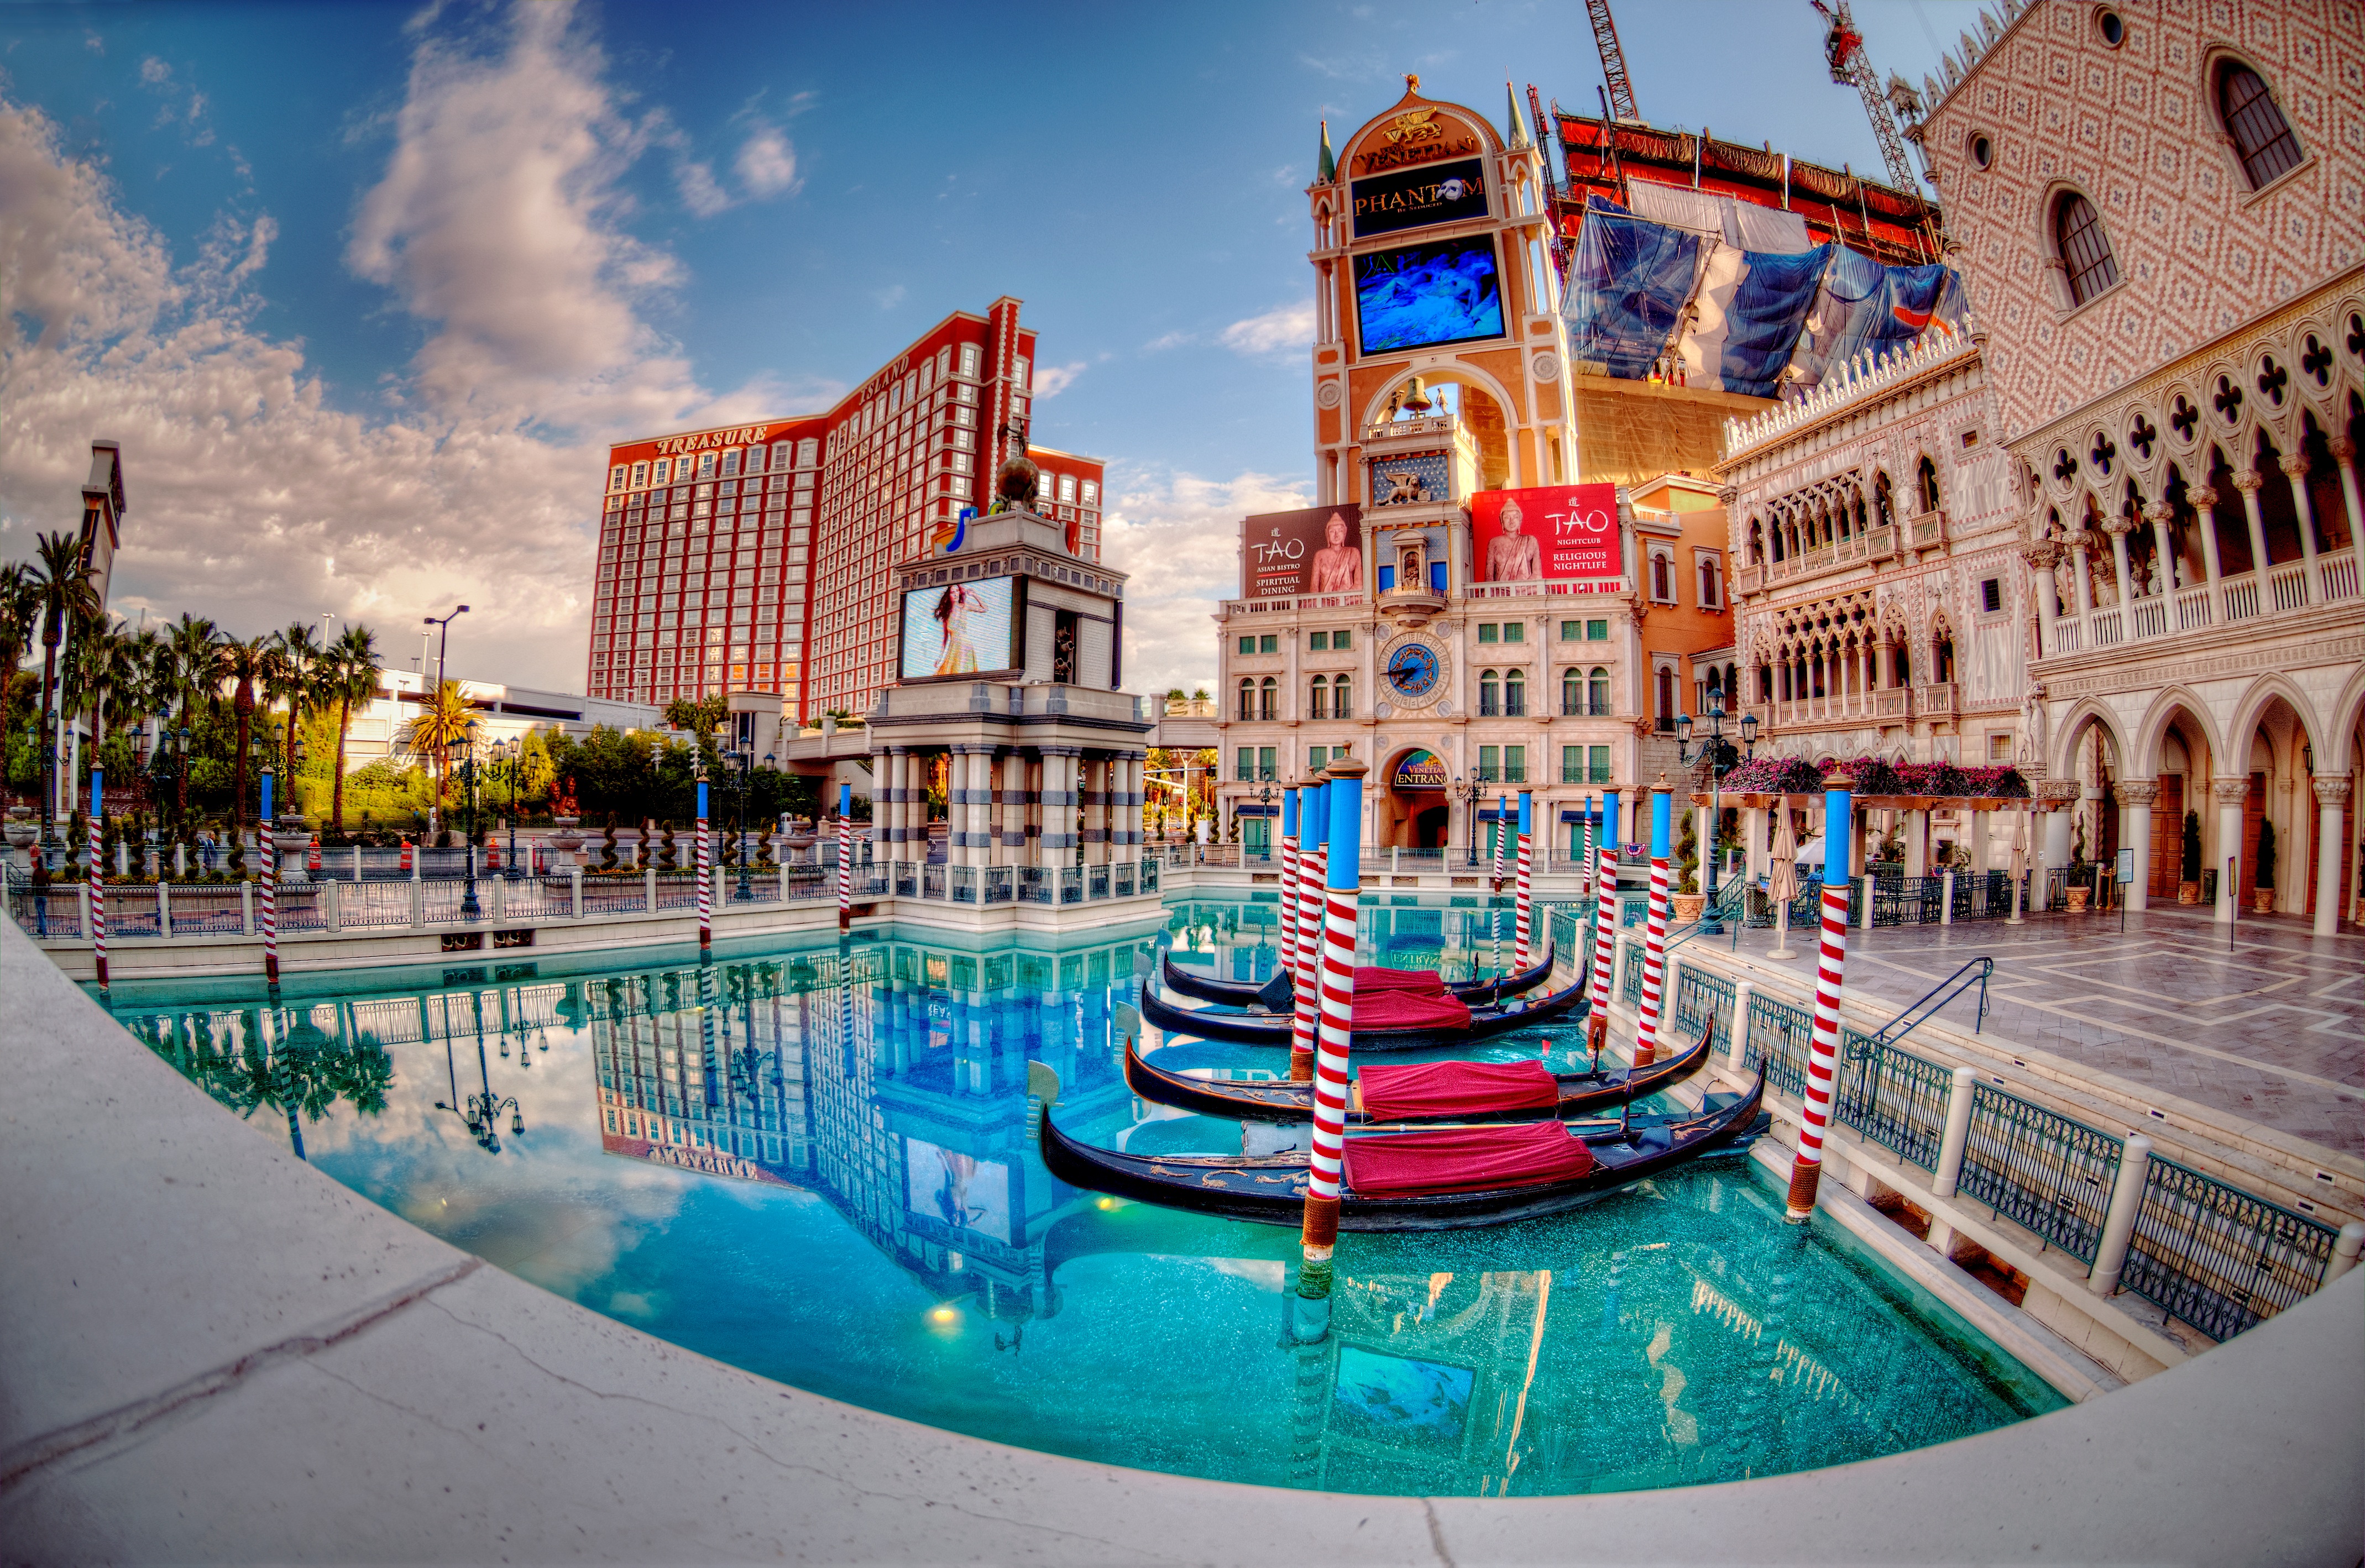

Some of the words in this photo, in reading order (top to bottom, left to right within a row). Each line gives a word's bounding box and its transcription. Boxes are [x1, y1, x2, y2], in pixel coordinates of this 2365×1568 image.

[1352, 136, 1473, 174] VENETIAN
[1353, 177, 1484, 217] PHANTM
[859, 355, 909, 406] ISLAND
[657, 426, 767, 454] TREASURE
[1544, 510, 1608, 536] TAO
[1250, 538, 1305, 564] TAO
[1553, 551, 1607, 561] RELIGIOUS
[1553, 561, 1607, 570] NIGHTLIFE
[1256, 576, 1300, 587] SPIRITUAL
[1261, 586, 1295, 595] DINING
[1408, 765, 1445, 774] VENETIAN
